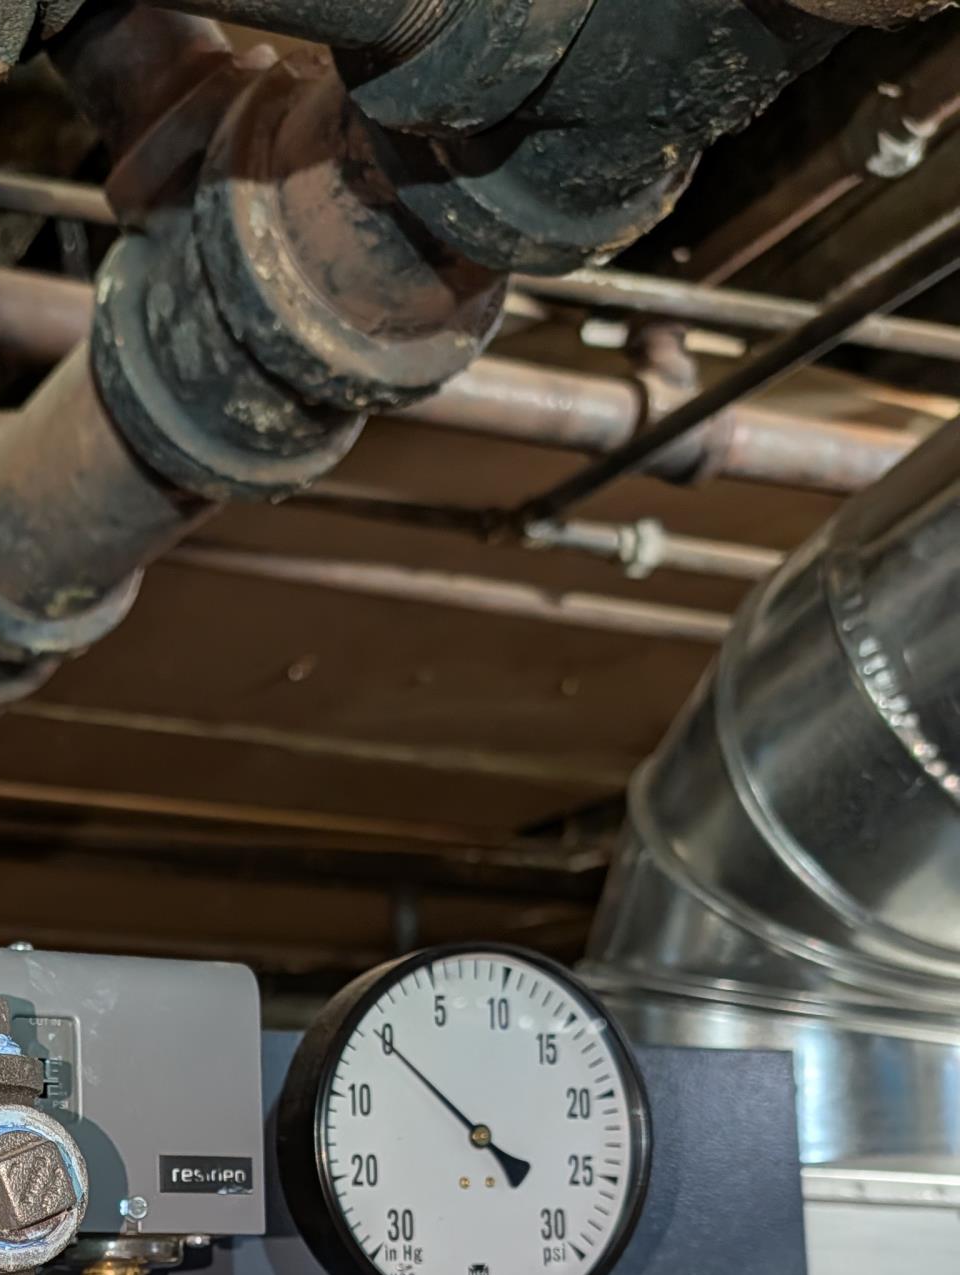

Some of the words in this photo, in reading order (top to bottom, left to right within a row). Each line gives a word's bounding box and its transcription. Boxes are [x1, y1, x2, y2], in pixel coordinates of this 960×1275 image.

[434, 995, 446, 1027] 5
[488, 998, 509, 1030] 10
[381, 1023, 393, 1055] 0
[536, 1033, 558, 1065] 15
[348, 1084, 371, 1117] 10
[566, 1088, 591, 1119] 20
[351, 1155, 378, 1187] 20
[568, 1155, 593, 1187] 25
[387, 1208, 414, 1242] 30
[540, 1208, 566, 1241] 30
[384, 1245, 397, 1261] in
[403, 1245, 423, 1265] Hg
[543, 1243, 566, 1266] psi
